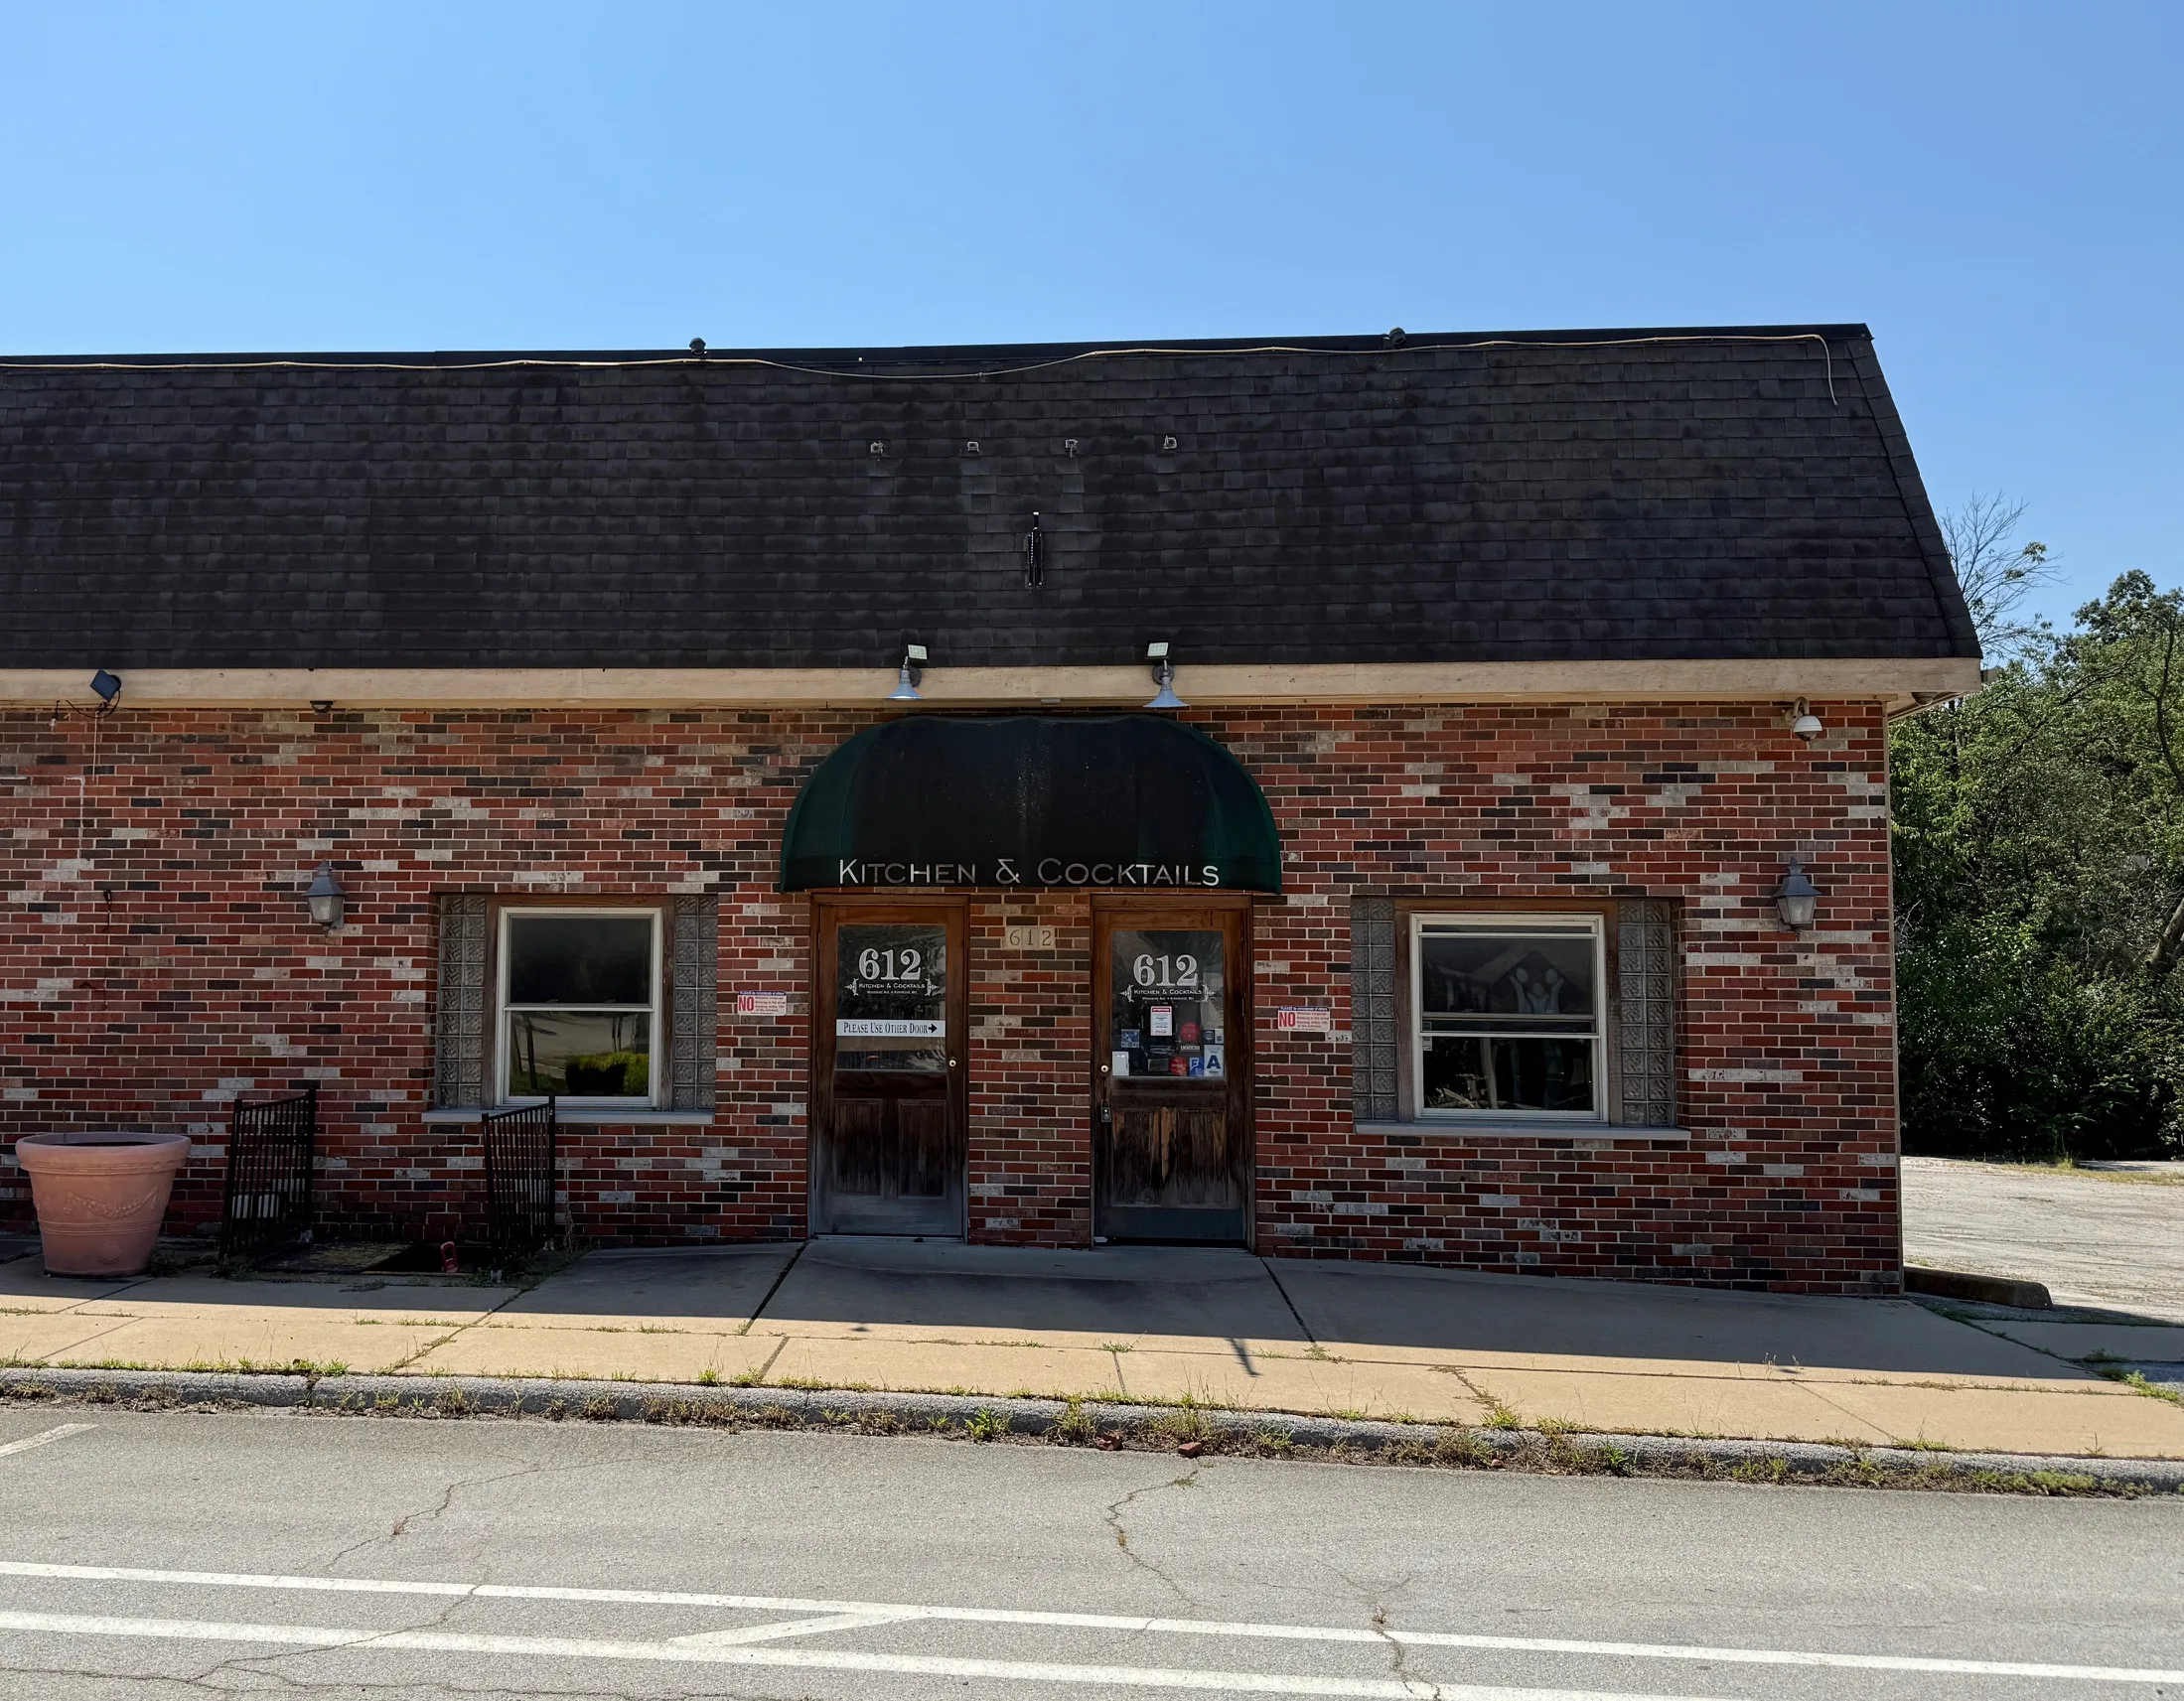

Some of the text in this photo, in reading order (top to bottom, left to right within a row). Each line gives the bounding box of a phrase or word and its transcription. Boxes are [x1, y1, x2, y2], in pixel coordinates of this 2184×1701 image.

[839, 858, 1220, 886] KITCHEN & COCKTAILS
[1009, 928, 1052, 946] 612
[858, 947, 921, 980] 612
[1133, 954, 1198, 986] 612
[739, 996, 755, 1011] NO
[1279, 1012, 1295, 1027] NO
[843, 1022, 929, 1034] PLEASE USE OTHER DOOR
[1207, 1055, 1221, 1069] A
